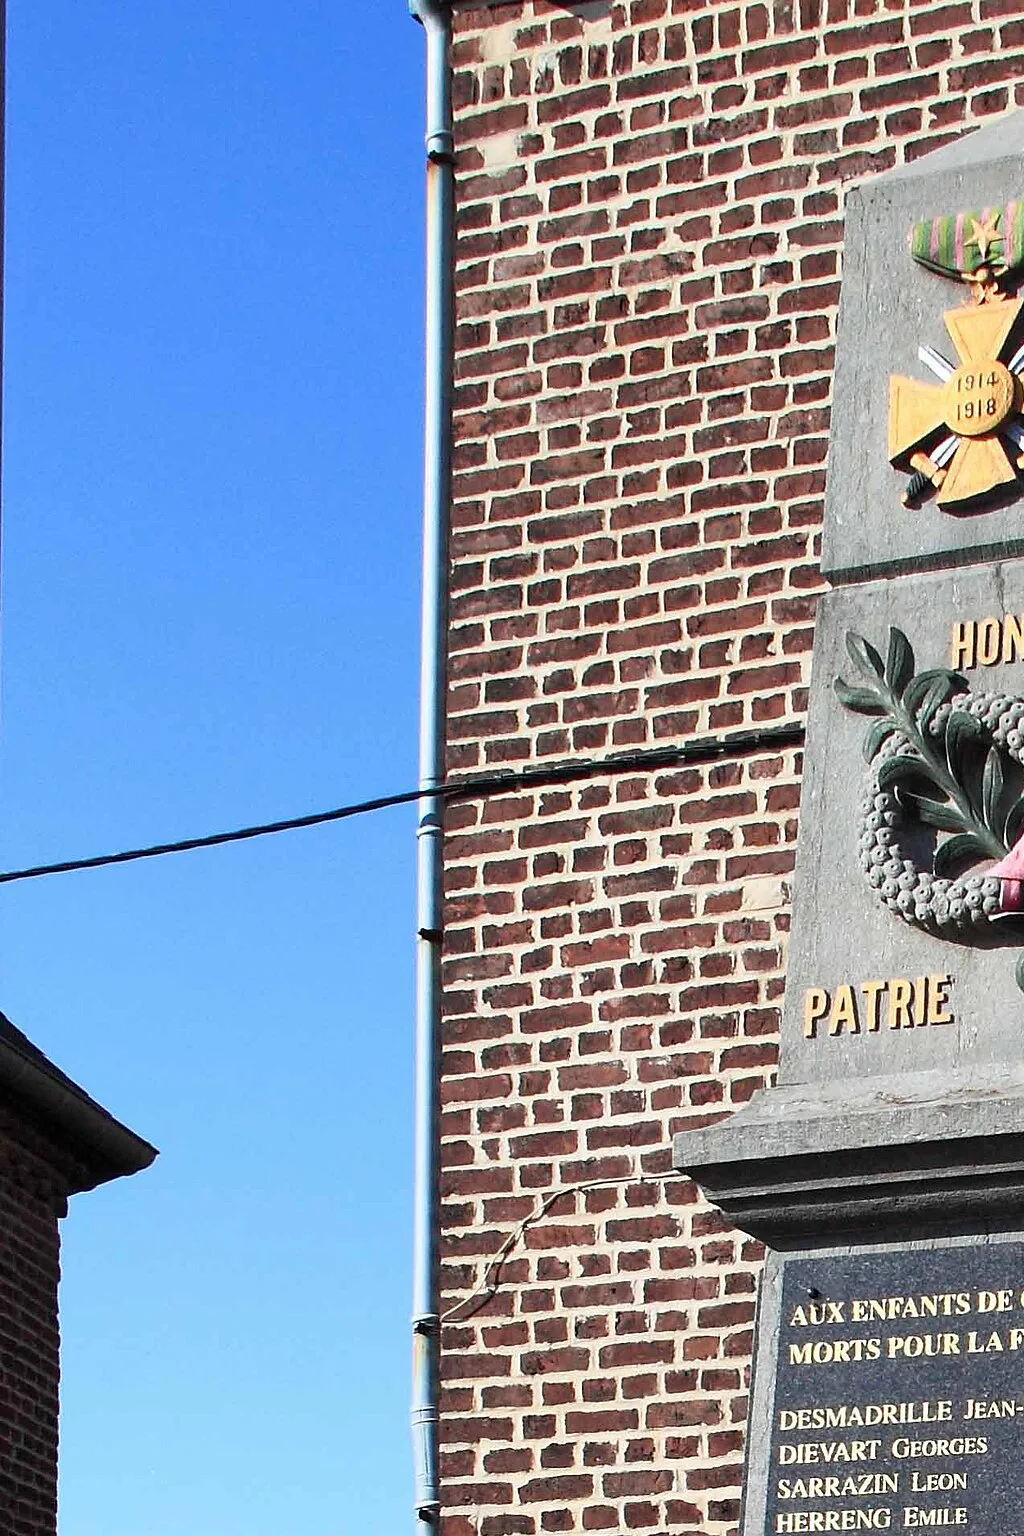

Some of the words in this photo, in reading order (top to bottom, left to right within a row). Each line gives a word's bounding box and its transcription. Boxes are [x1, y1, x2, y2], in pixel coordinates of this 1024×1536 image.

[957, 371, 999, 392] 1914
[956, 398, 997, 421] 1918
[803, 973, 954, 1037] PATRIE
[789, 1301, 846, 1327] AUX
[851, 1292, 971, 1322] ENFANTS
[977, 1289, 1014, 1313] DE
[788, 1338, 881, 1365] MORTS
[886, 1333, 961, 1359] POUR
[966, 1330, 1004, 1353] LA
